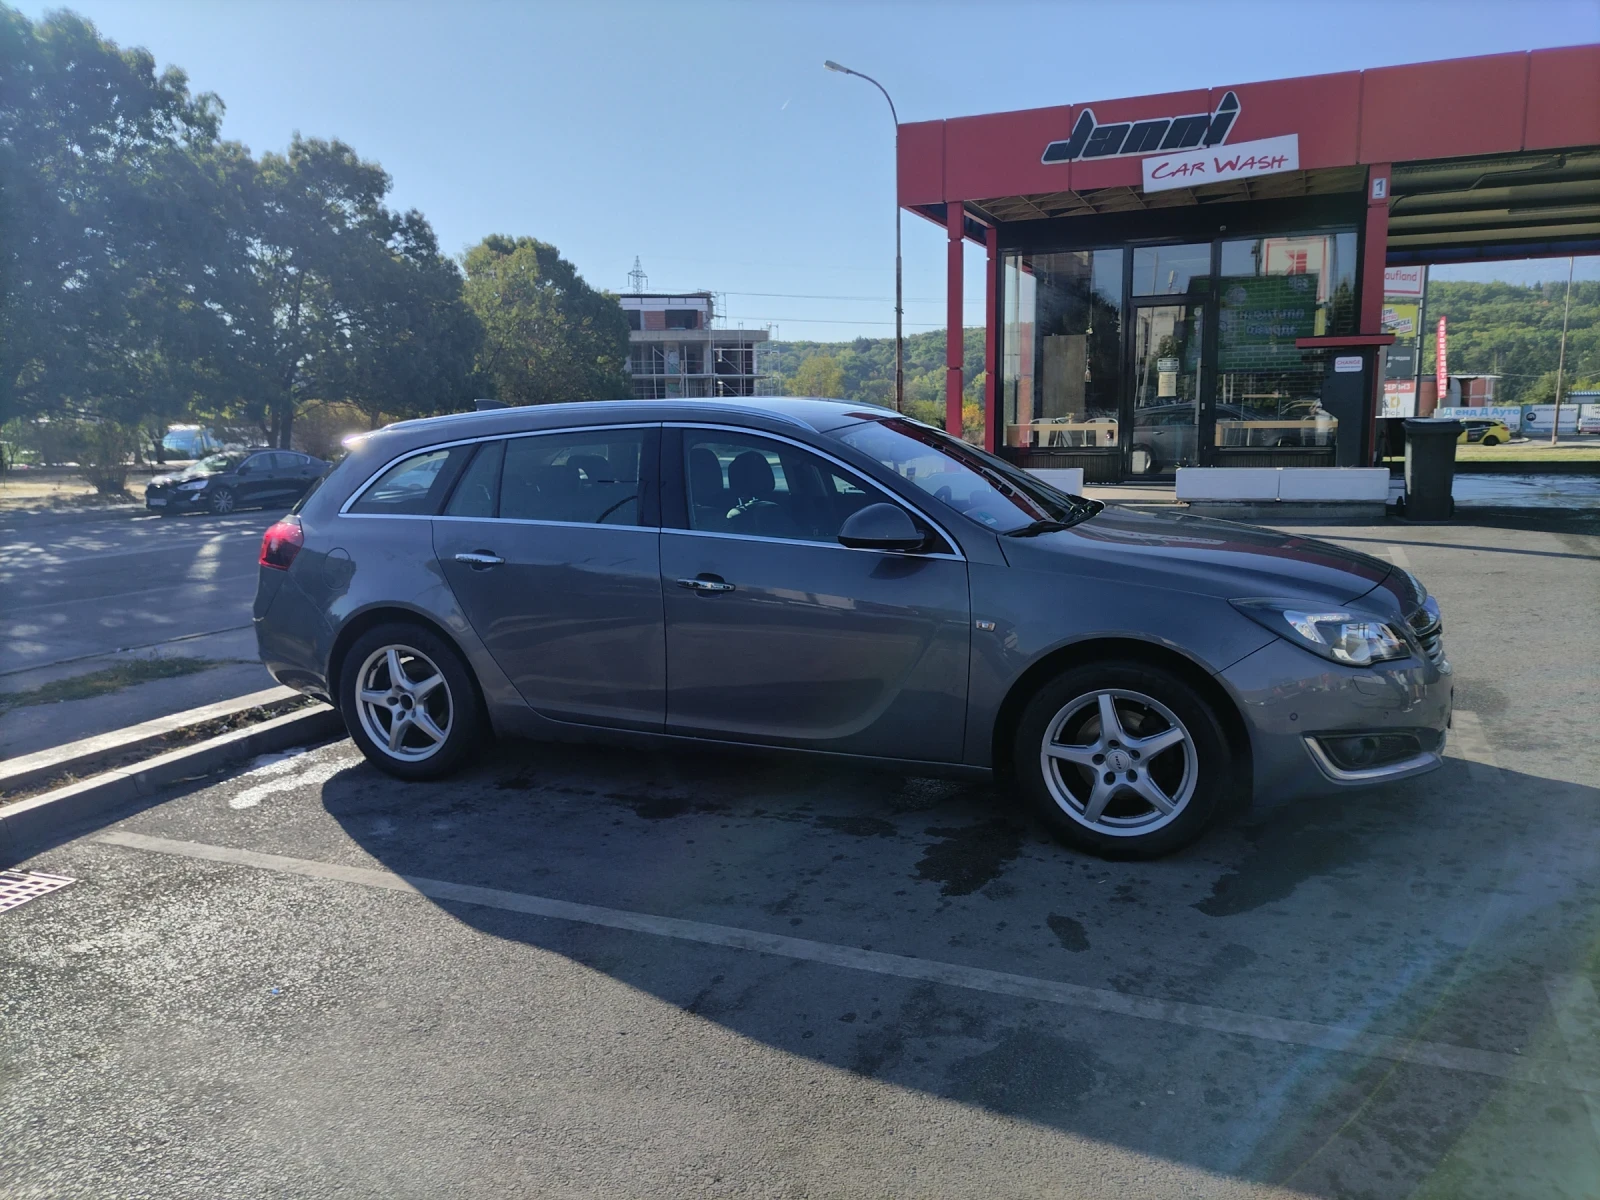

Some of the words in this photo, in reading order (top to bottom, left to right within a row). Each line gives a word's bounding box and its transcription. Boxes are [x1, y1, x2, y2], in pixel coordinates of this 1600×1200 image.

[1151, 161, 1206, 180] CAR
[1213, 154, 1289, 176] WASH
[1375, 179, 1384, 192] 1
[1384, 269, 1418, 282] aufland
[1491, 407, 1520, 417] Ауто
